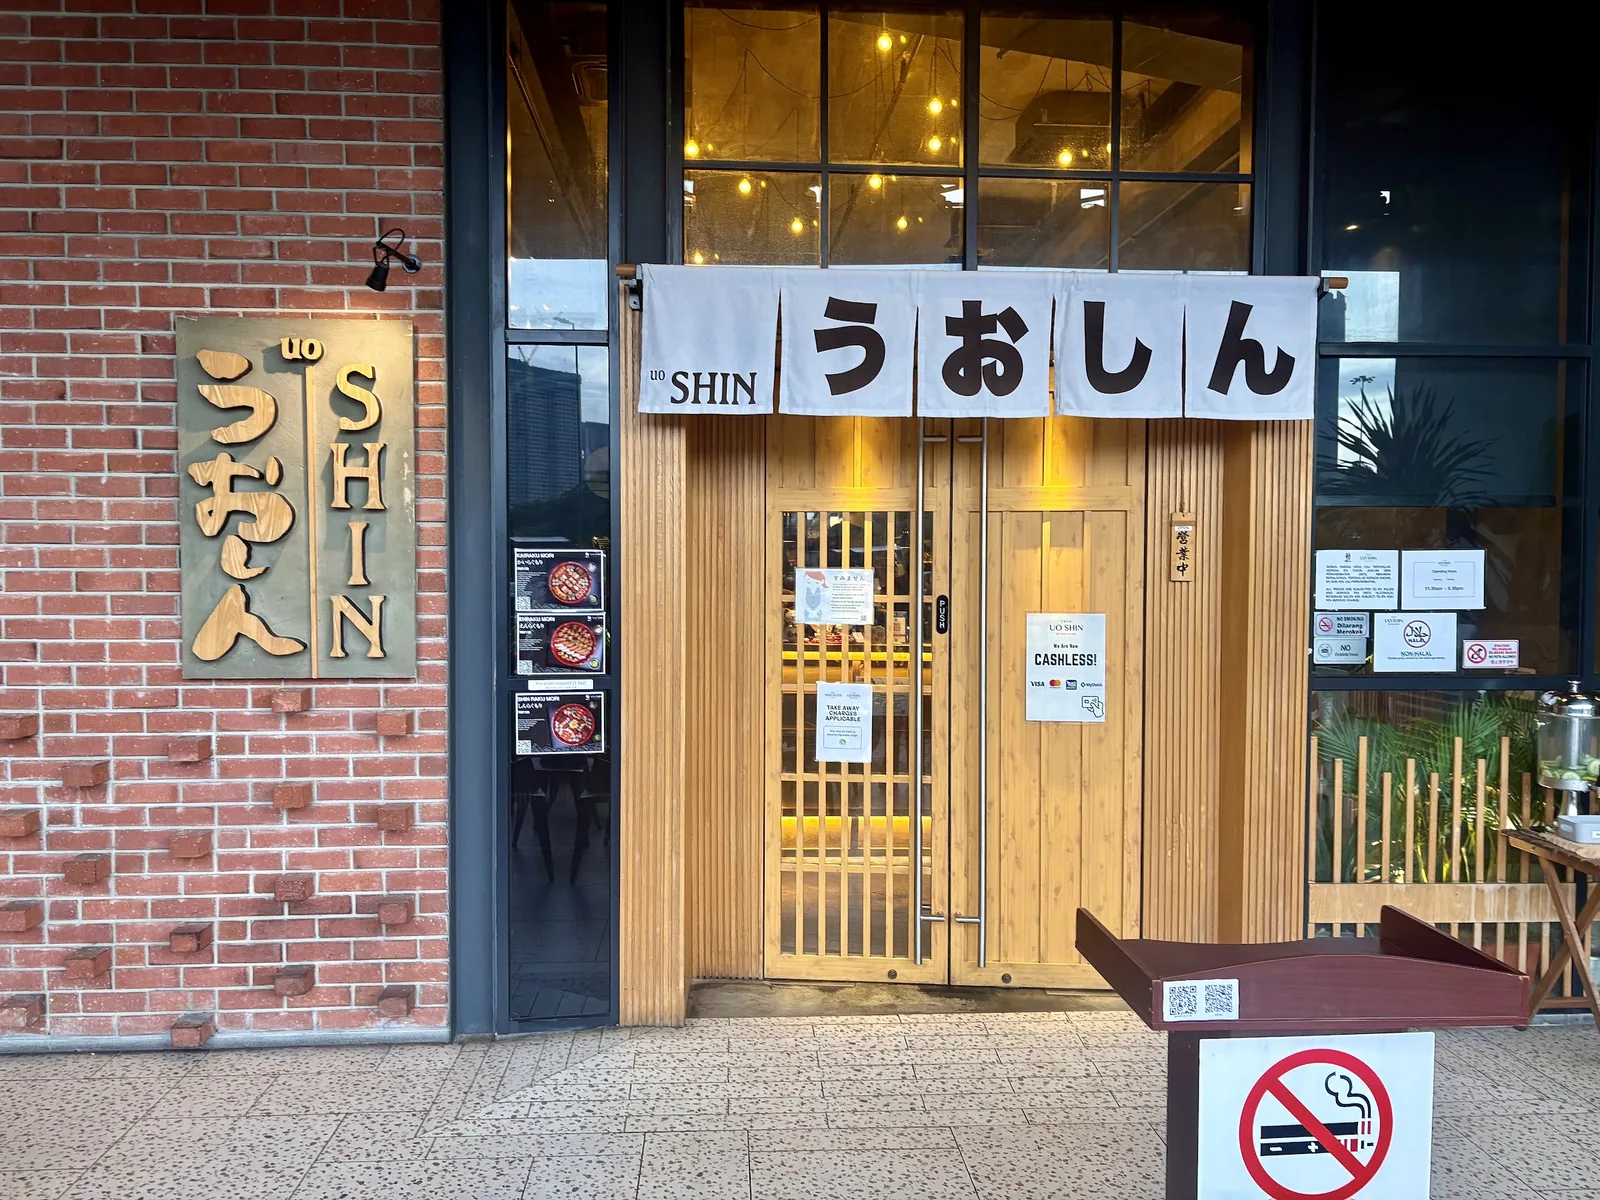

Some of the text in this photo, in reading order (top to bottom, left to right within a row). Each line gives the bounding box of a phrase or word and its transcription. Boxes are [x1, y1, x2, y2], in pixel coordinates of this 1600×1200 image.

[670, 371, 758, 405] SHIN
[329, 363, 387, 659] SHIN
[1034, 653, 1097, 666] CASHLESS!
